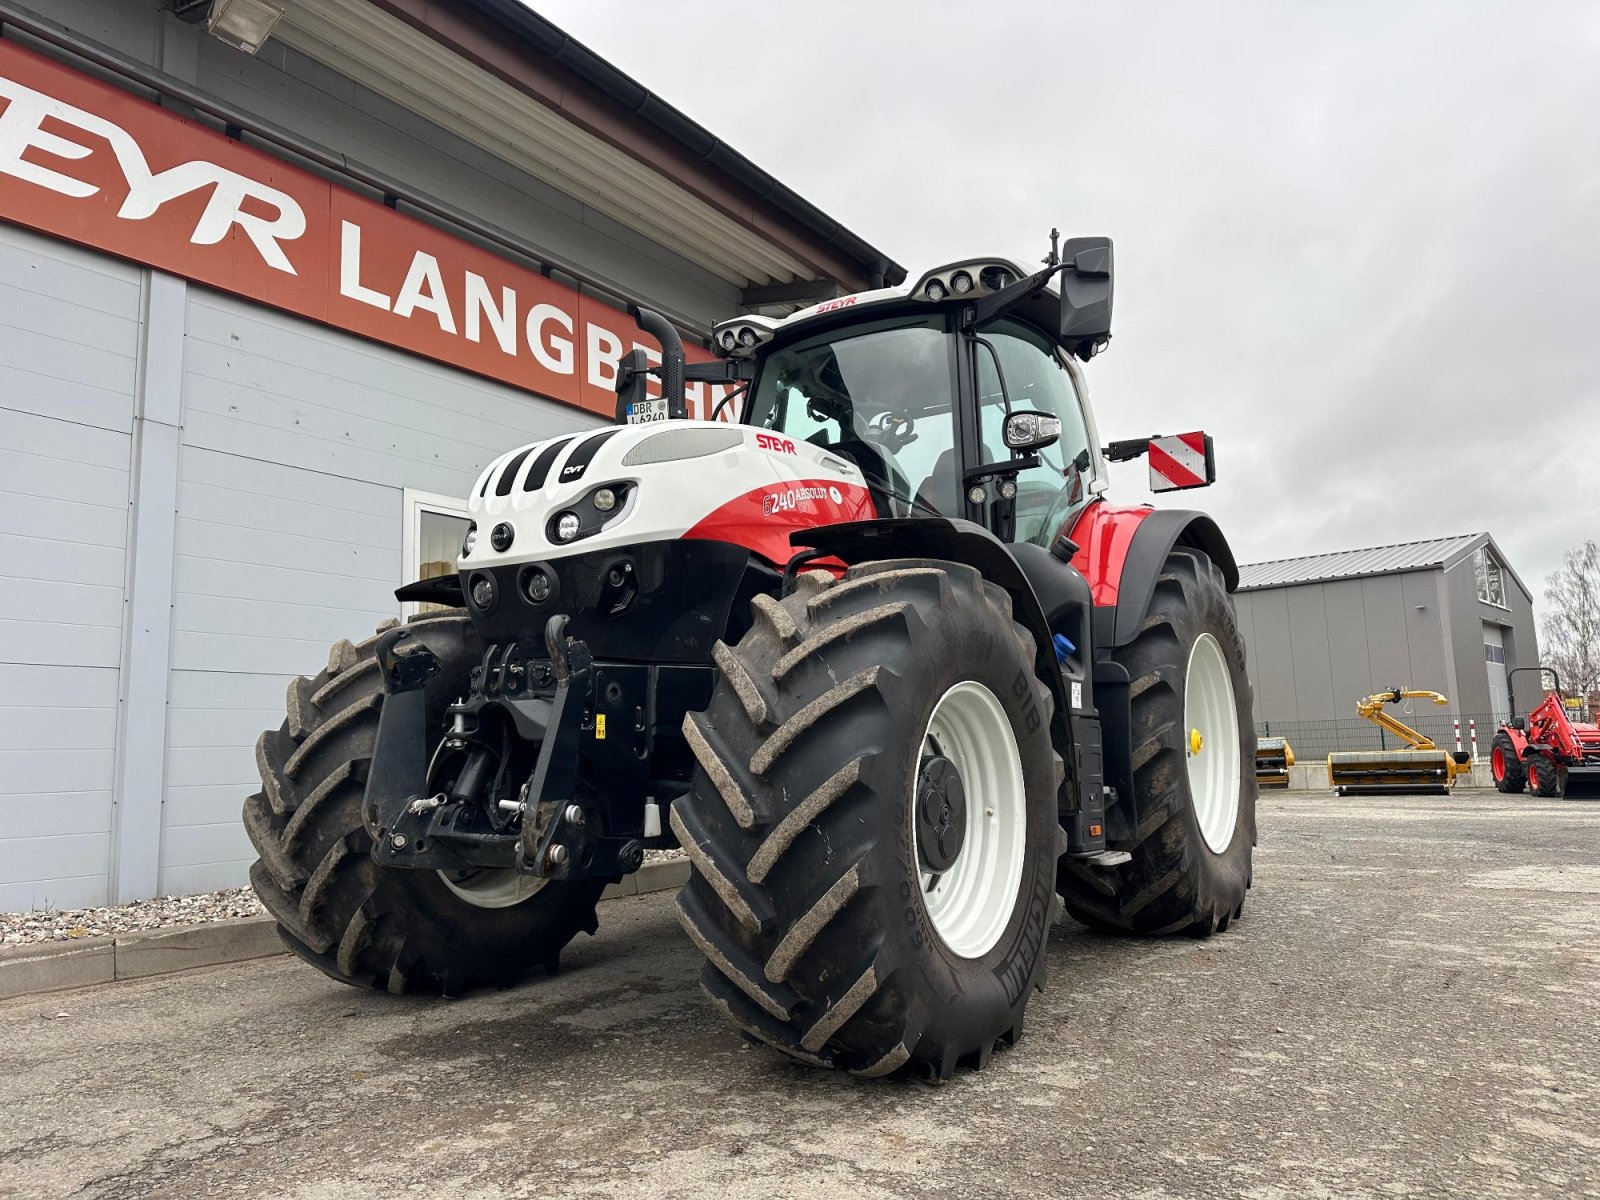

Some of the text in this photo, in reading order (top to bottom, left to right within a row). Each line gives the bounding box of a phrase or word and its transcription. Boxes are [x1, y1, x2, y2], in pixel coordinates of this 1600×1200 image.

[0, 76, 307, 276] EYR
[816, 296, 857, 314] STEYR
[633, 402, 652, 415] DBR
[755, 433, 798, 456] STEYR
[563, 464, 585, 475] CVT
[762, 489, 796, 517] 6240
[795, 487, 828, 501] ABSOLUT
[998, 848, 1051, 1006] MICHELIN
